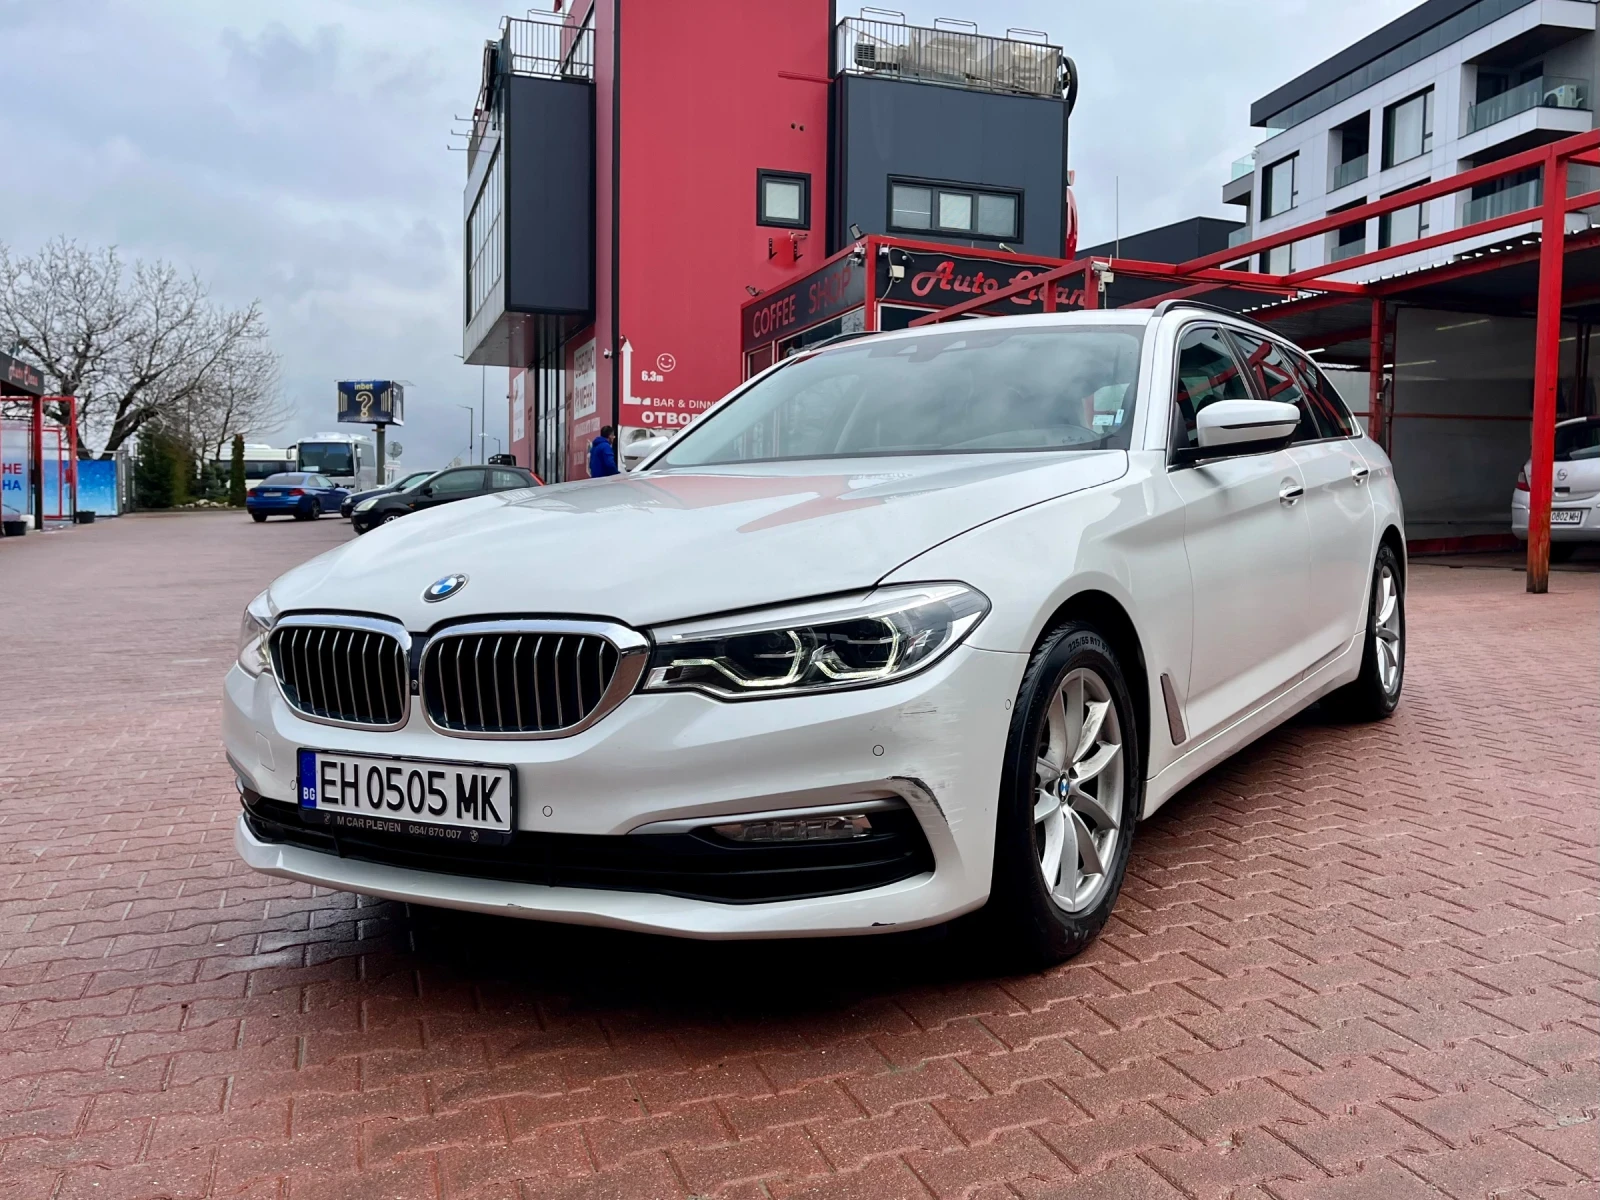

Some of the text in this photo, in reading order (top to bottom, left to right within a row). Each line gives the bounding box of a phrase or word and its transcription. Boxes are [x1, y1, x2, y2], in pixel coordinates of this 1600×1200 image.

[911, 261, 998, 297] Auto
[753, 266, 851, 338] COFFEE SHOP
[641, 370, 664, 382] 6.3m
[354, 382, 374, 390] inbet
[653, 397, 675, 408] BAR
[677, 399, 686, 408] &
[1552, 511, 1569, 522] 0802
[303, 786, 316, 801] BG
[320, 760, 504, 824] EH 0505 MK
[336, 815, 462, 839] M CAR PLEVEN 064/ 870 007
